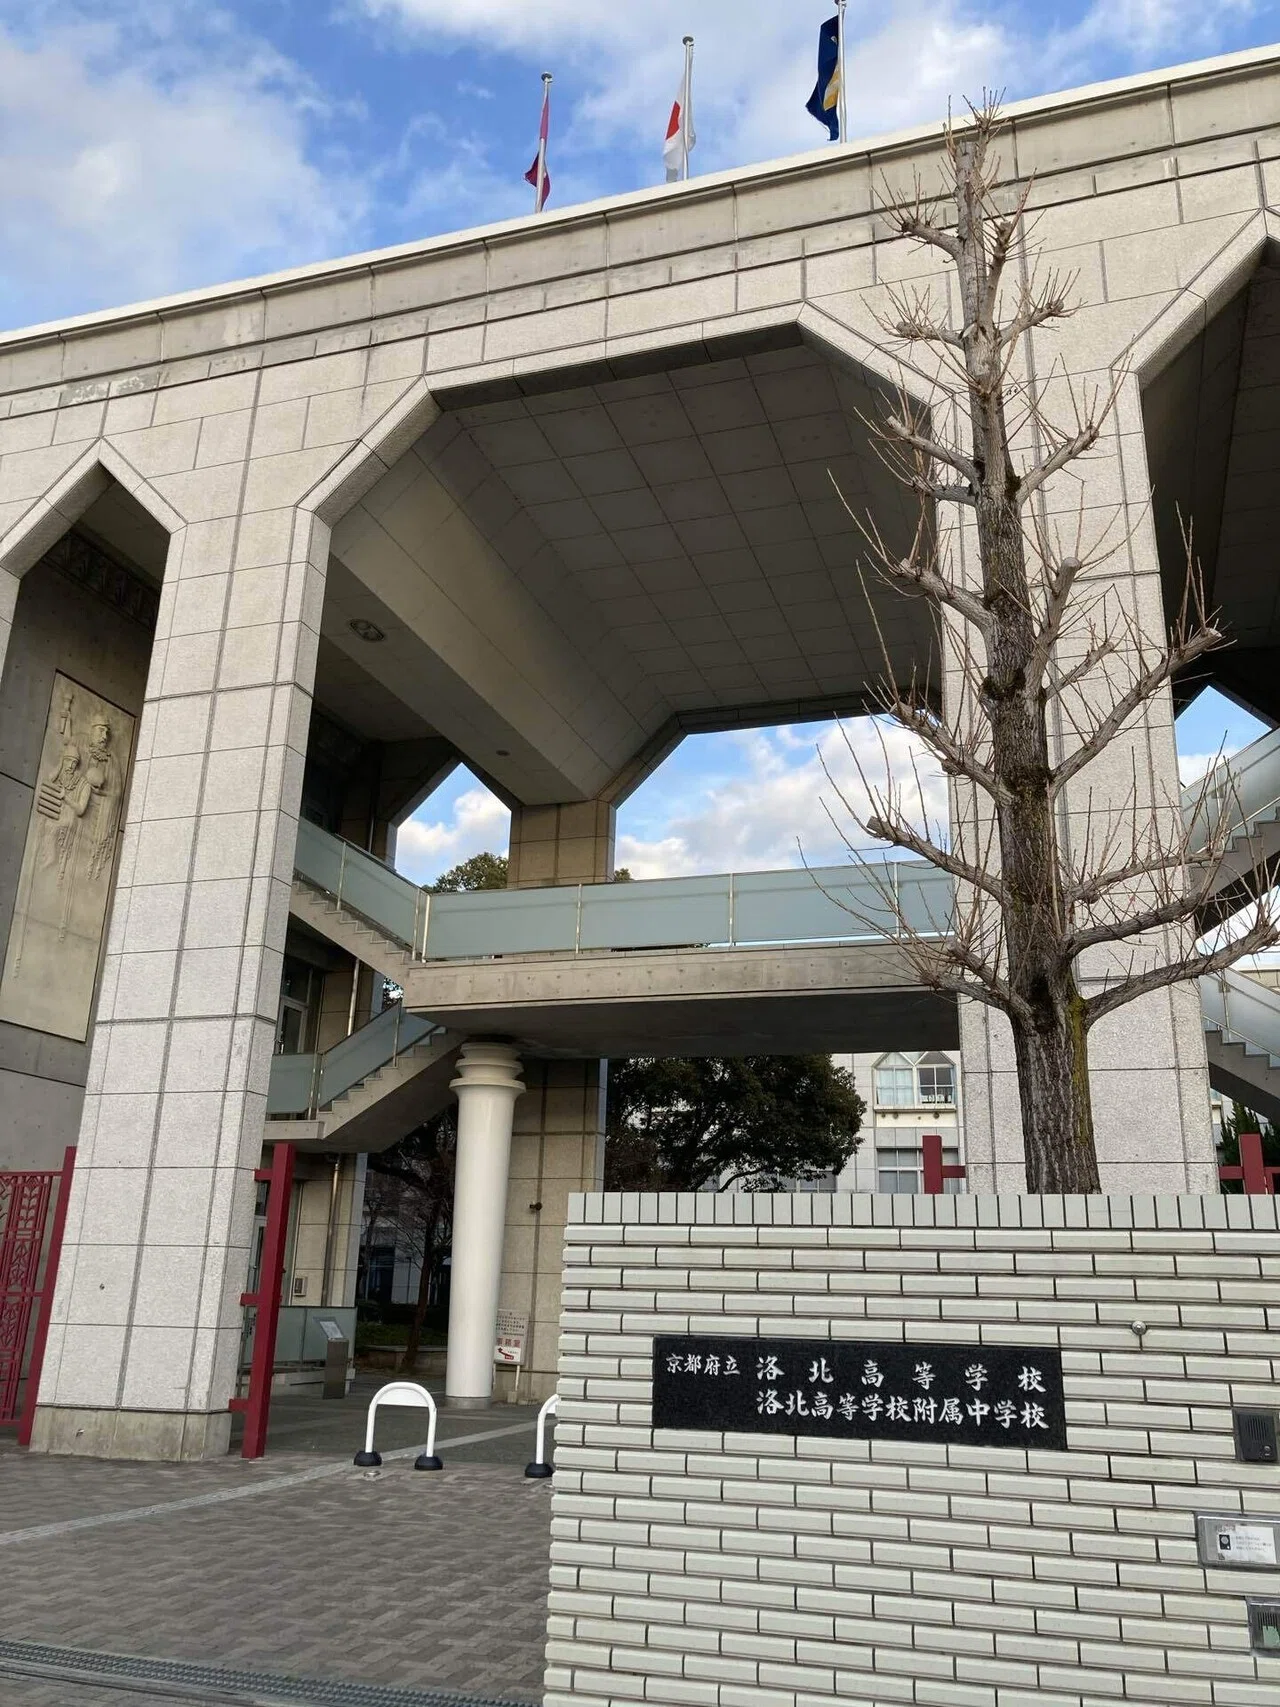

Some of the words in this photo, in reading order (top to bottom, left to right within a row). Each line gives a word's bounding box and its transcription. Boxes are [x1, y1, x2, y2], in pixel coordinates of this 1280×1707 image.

[666, 1353, 741, 1376] 京都府立
[756, 1388, 1050, 1429] 洛北高等学校附属中学校
